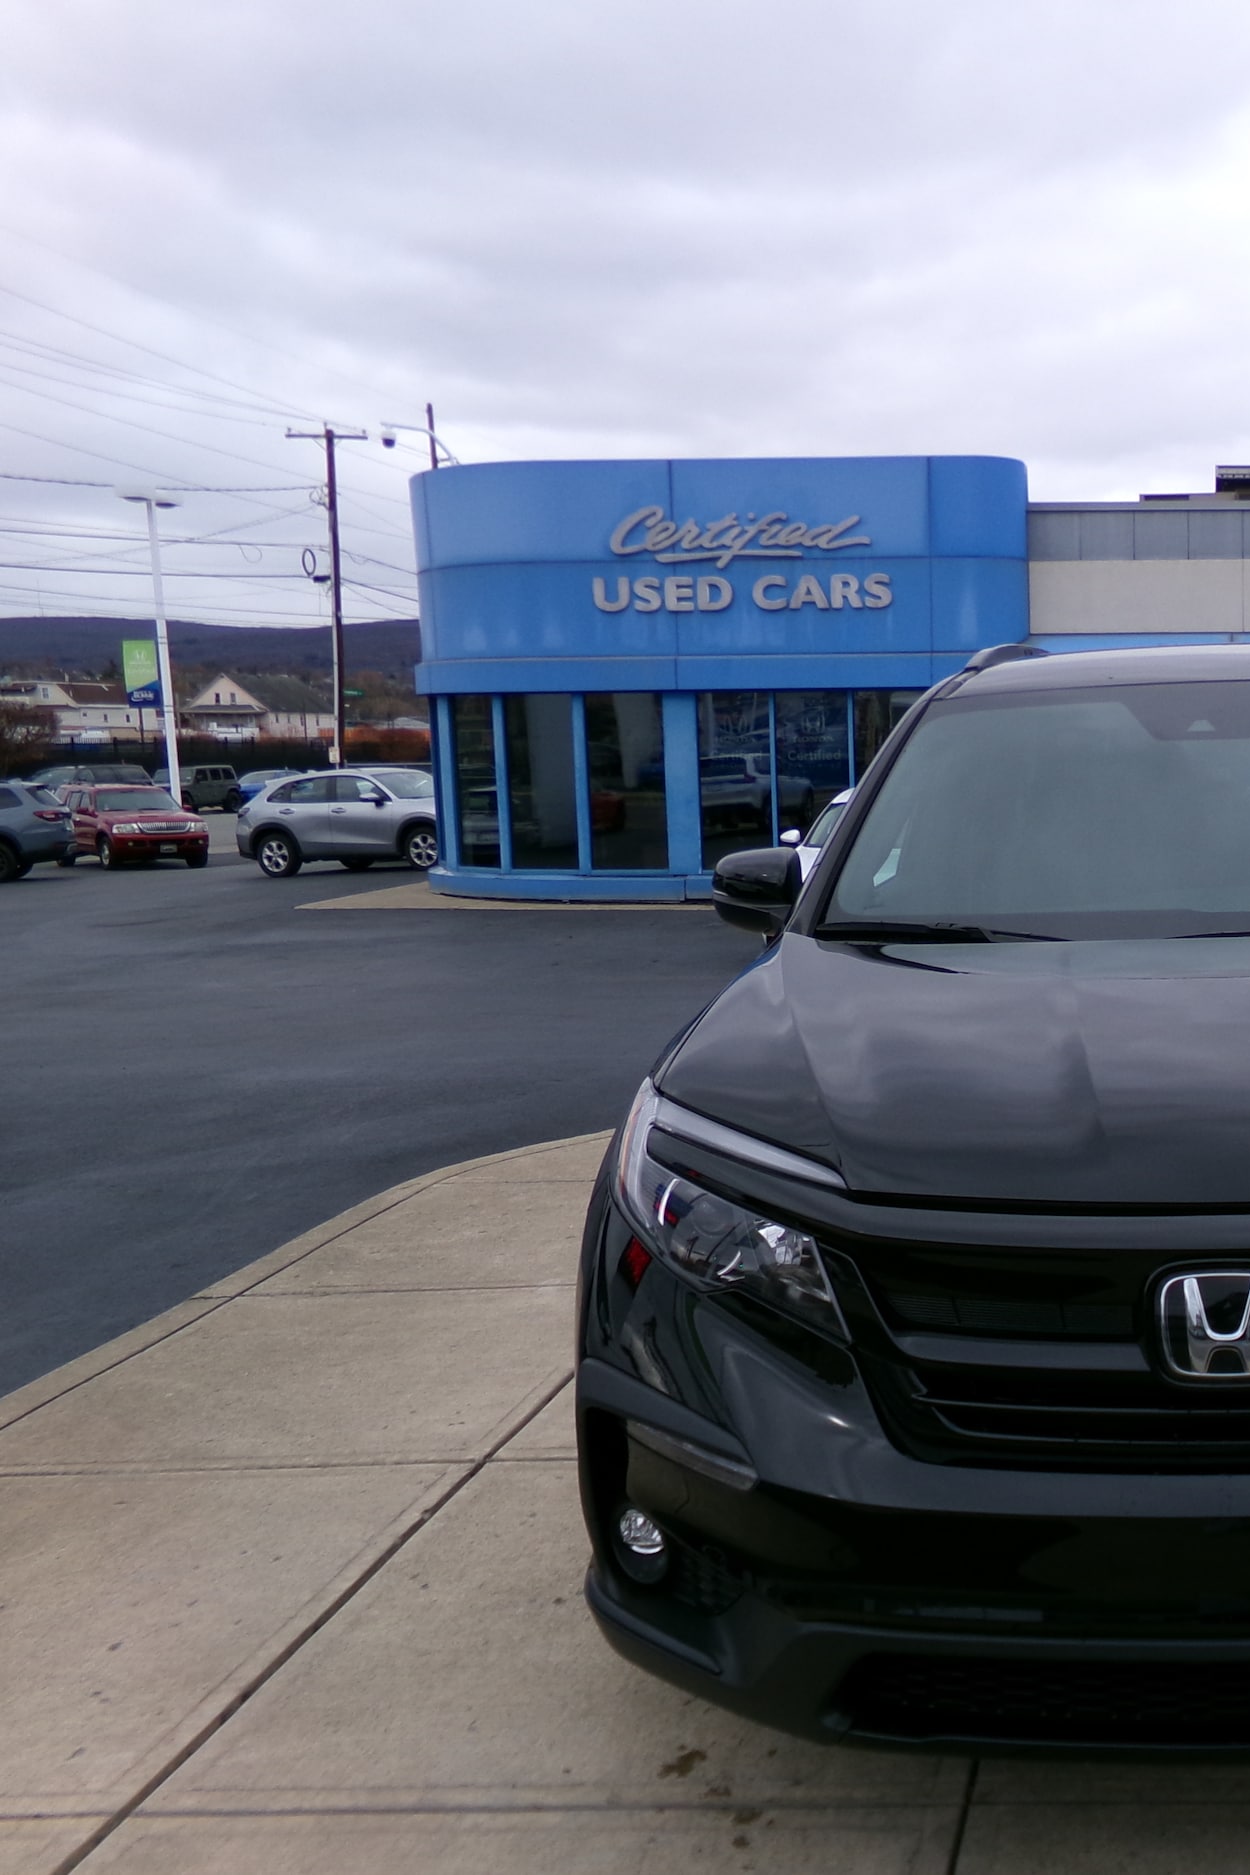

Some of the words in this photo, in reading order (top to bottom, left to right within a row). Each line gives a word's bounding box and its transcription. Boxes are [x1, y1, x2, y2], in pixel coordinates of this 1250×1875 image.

[609, 505, 871, 569] Certified
[592, 576, 733, 612] USED
[752, 573, 893, 610] CARS
